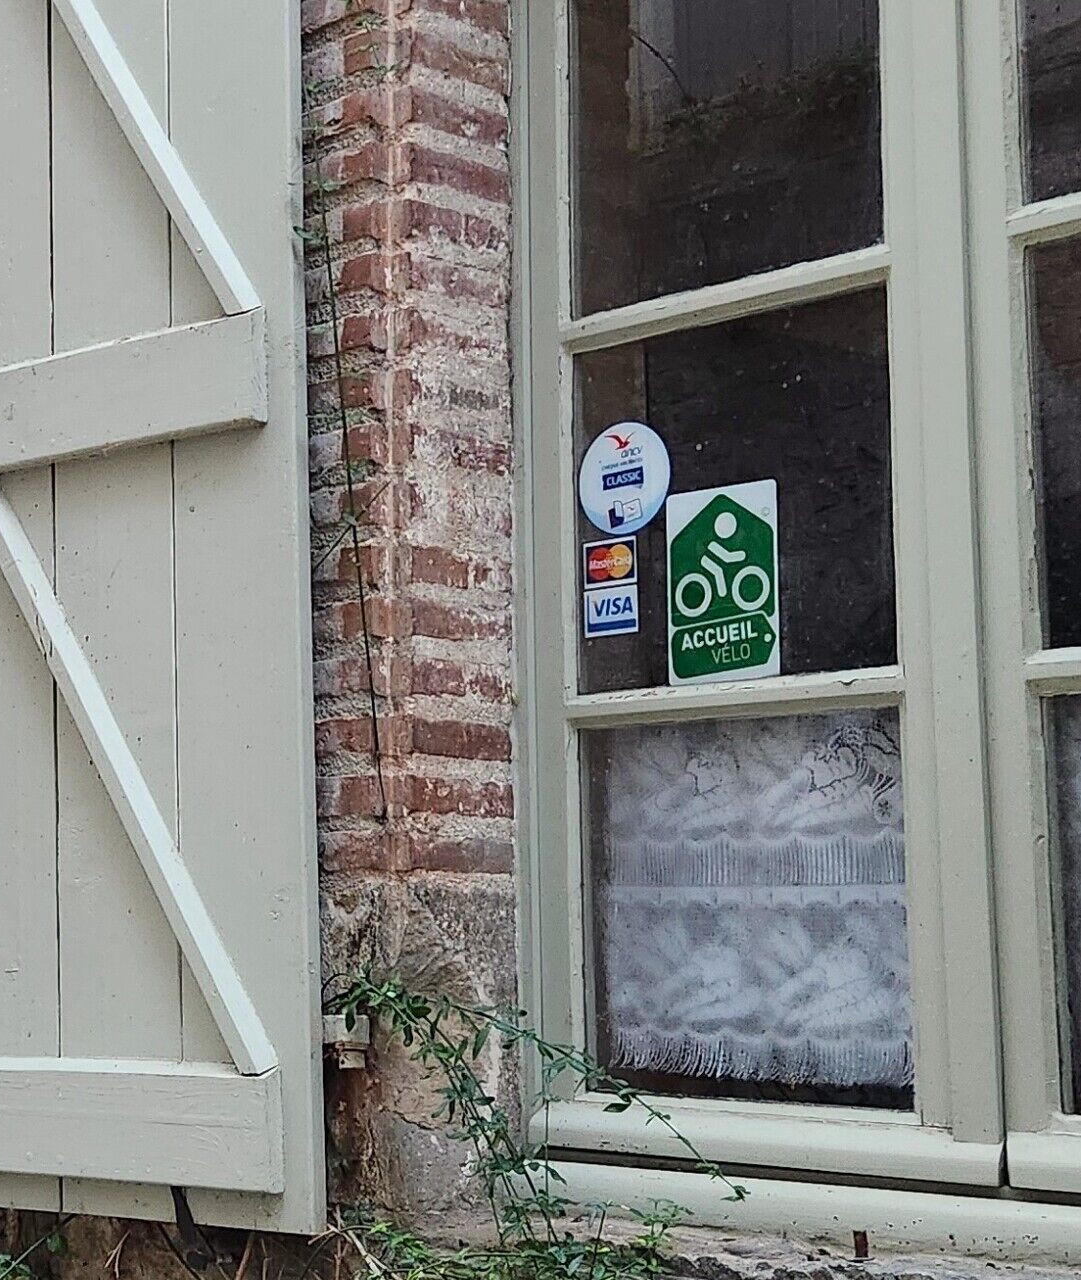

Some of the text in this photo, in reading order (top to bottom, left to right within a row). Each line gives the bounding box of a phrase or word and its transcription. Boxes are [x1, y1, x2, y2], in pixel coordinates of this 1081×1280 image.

[606, 470, 641, 486] CLASSIC
[593, 596, 633, 617] VISA
[681, 620, 758, 651] ACCUEIL
[711, 643, 751, 664] VÉLO
